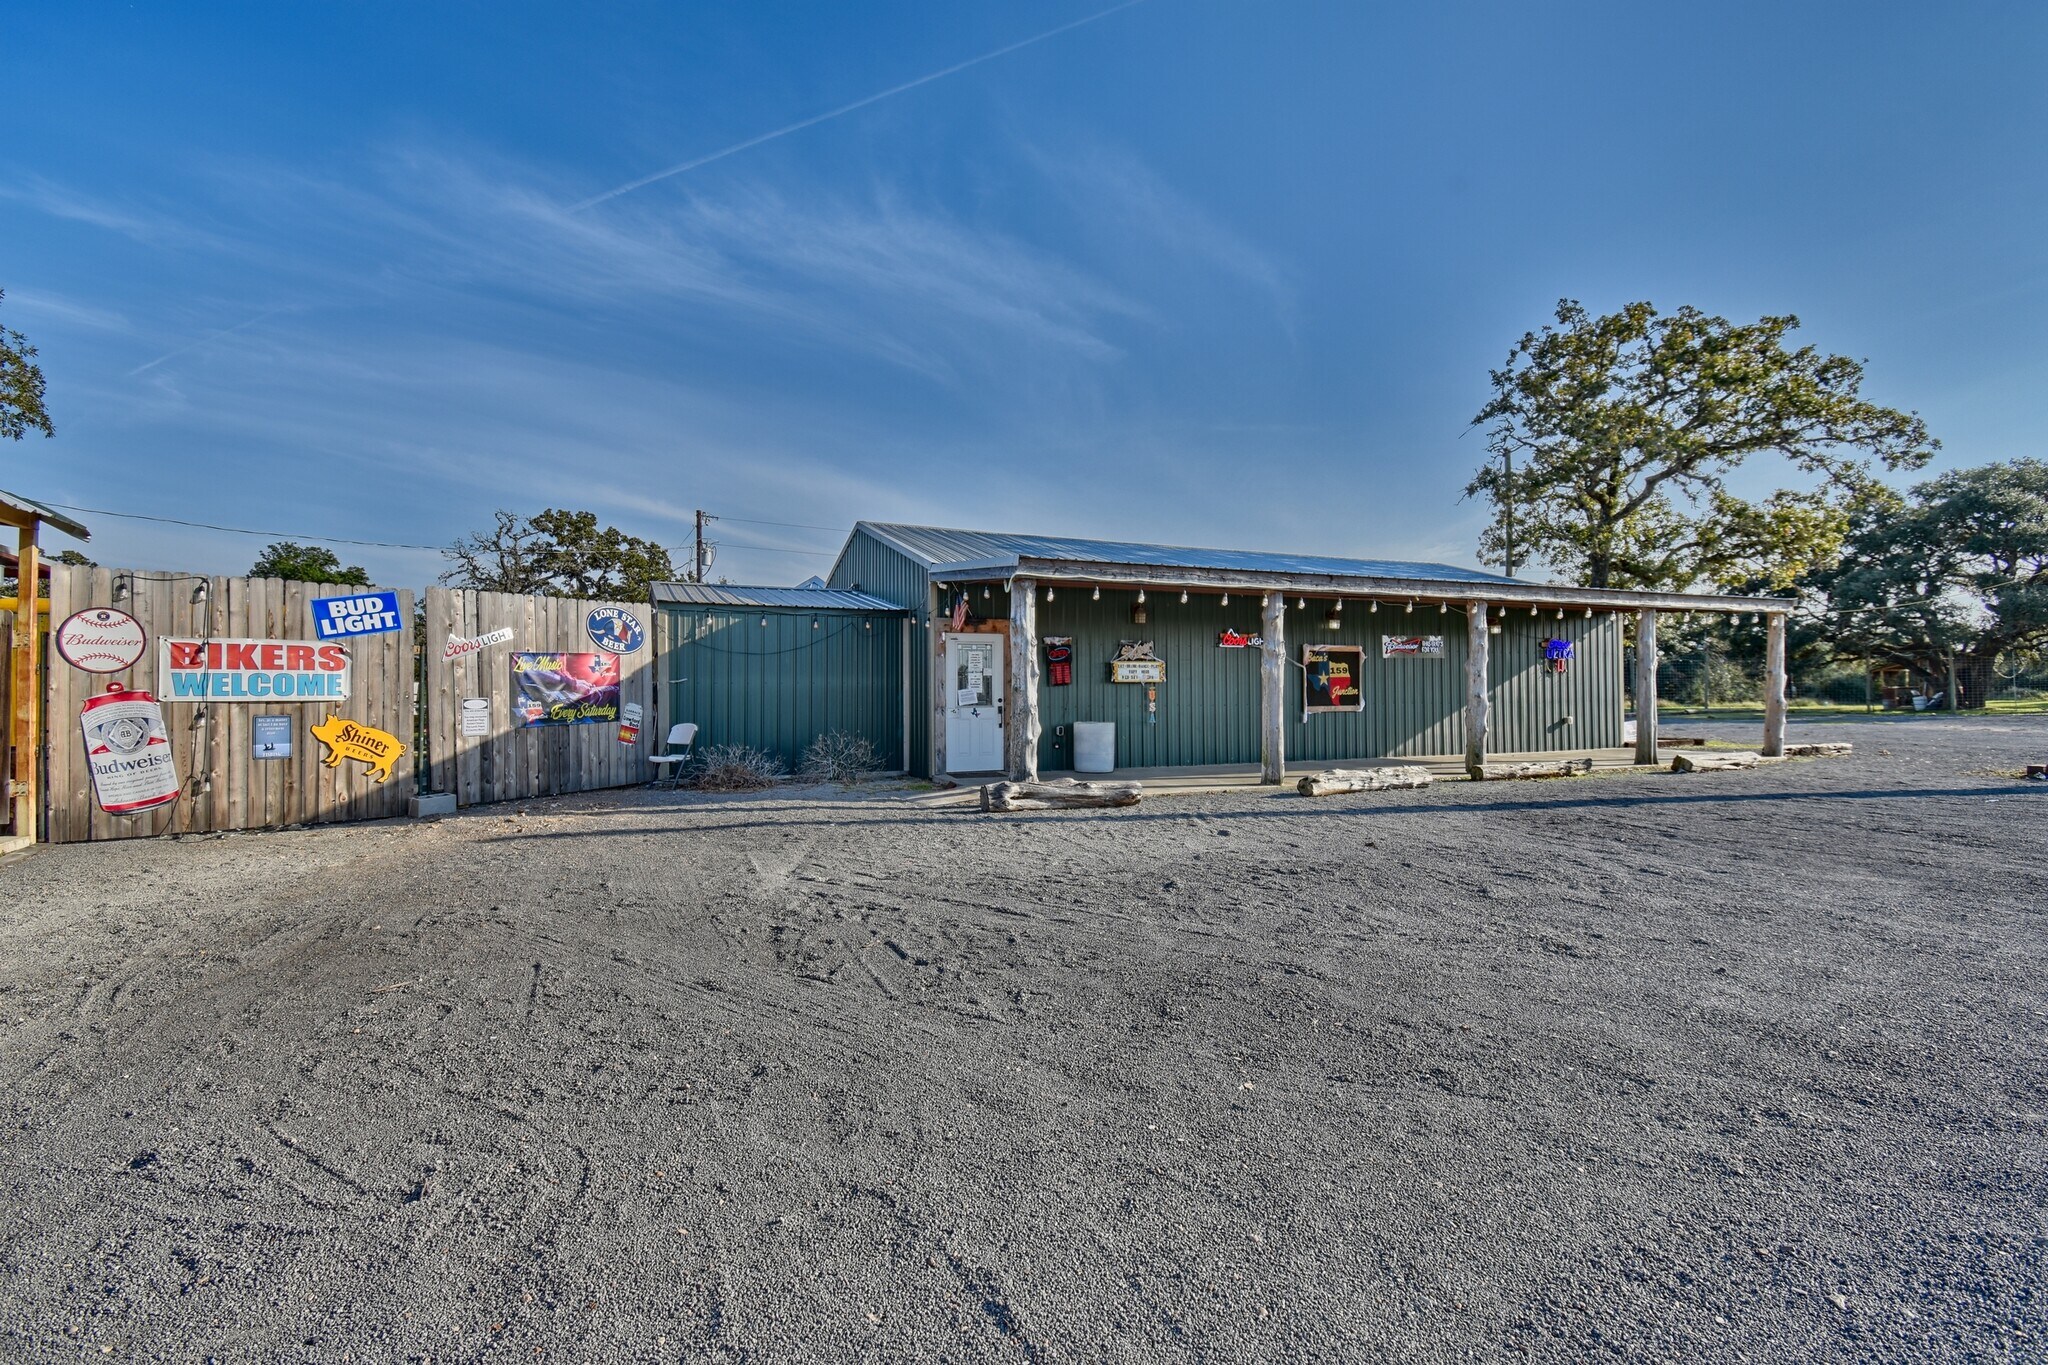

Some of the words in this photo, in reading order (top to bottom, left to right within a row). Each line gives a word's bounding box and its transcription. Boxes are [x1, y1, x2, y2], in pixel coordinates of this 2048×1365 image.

[328, 597, 384, 618] BUD
[594, 609, 619, 621] LONE
[621, 613, 642, 635] STAR
[63, 633, 142, 647] Budweiser
[445, 639, 481, 657] Coors
[481, 630, 509, 646] LIGH
[602, 637, 626, 651] BEER
[1222, 633, 1249, 646] Coors
[1247, 637, 1264, 646] LIGH
[170, 642, 346, 671] BIKERS
[513, 656, 533, 673] Live
[533, 655, 563, 671] Music
[1546, 649, 1575, 659] ULTRA
[171, 673, 343, 697] WELCOME
[1332, 685, 1359, 699] Junction
[551, 703, 577, 722] Every
[577, 702, 617, 720] Saturday
[335, 724, 390, 754] Shiner
[345, 746, 374, 759] BEERS
[91, 753, 171, 776] Budweiser
